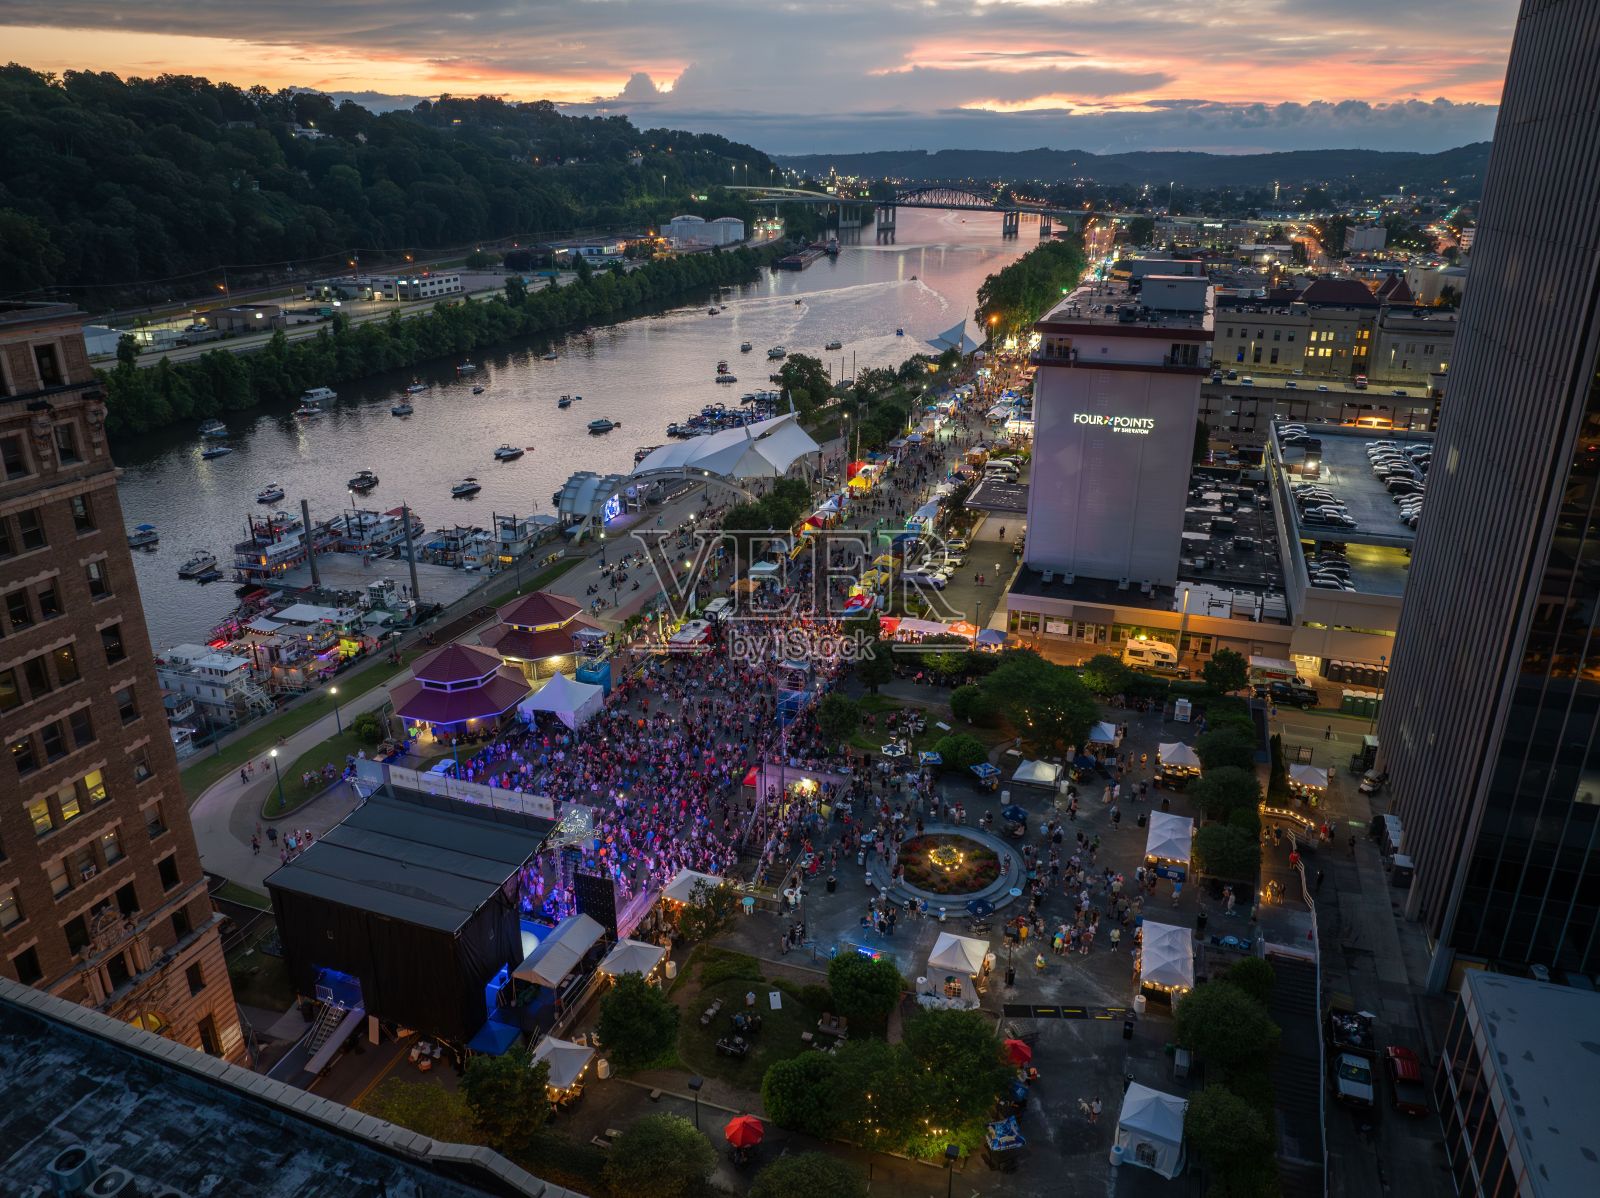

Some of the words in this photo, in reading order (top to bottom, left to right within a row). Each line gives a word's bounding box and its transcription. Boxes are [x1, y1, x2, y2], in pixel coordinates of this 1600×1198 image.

[1073, 413, 1104, 425] FOUR
[1114, 417, 1154, 429] POINTS
[1121, 427, 1149, 435] SHERATON
